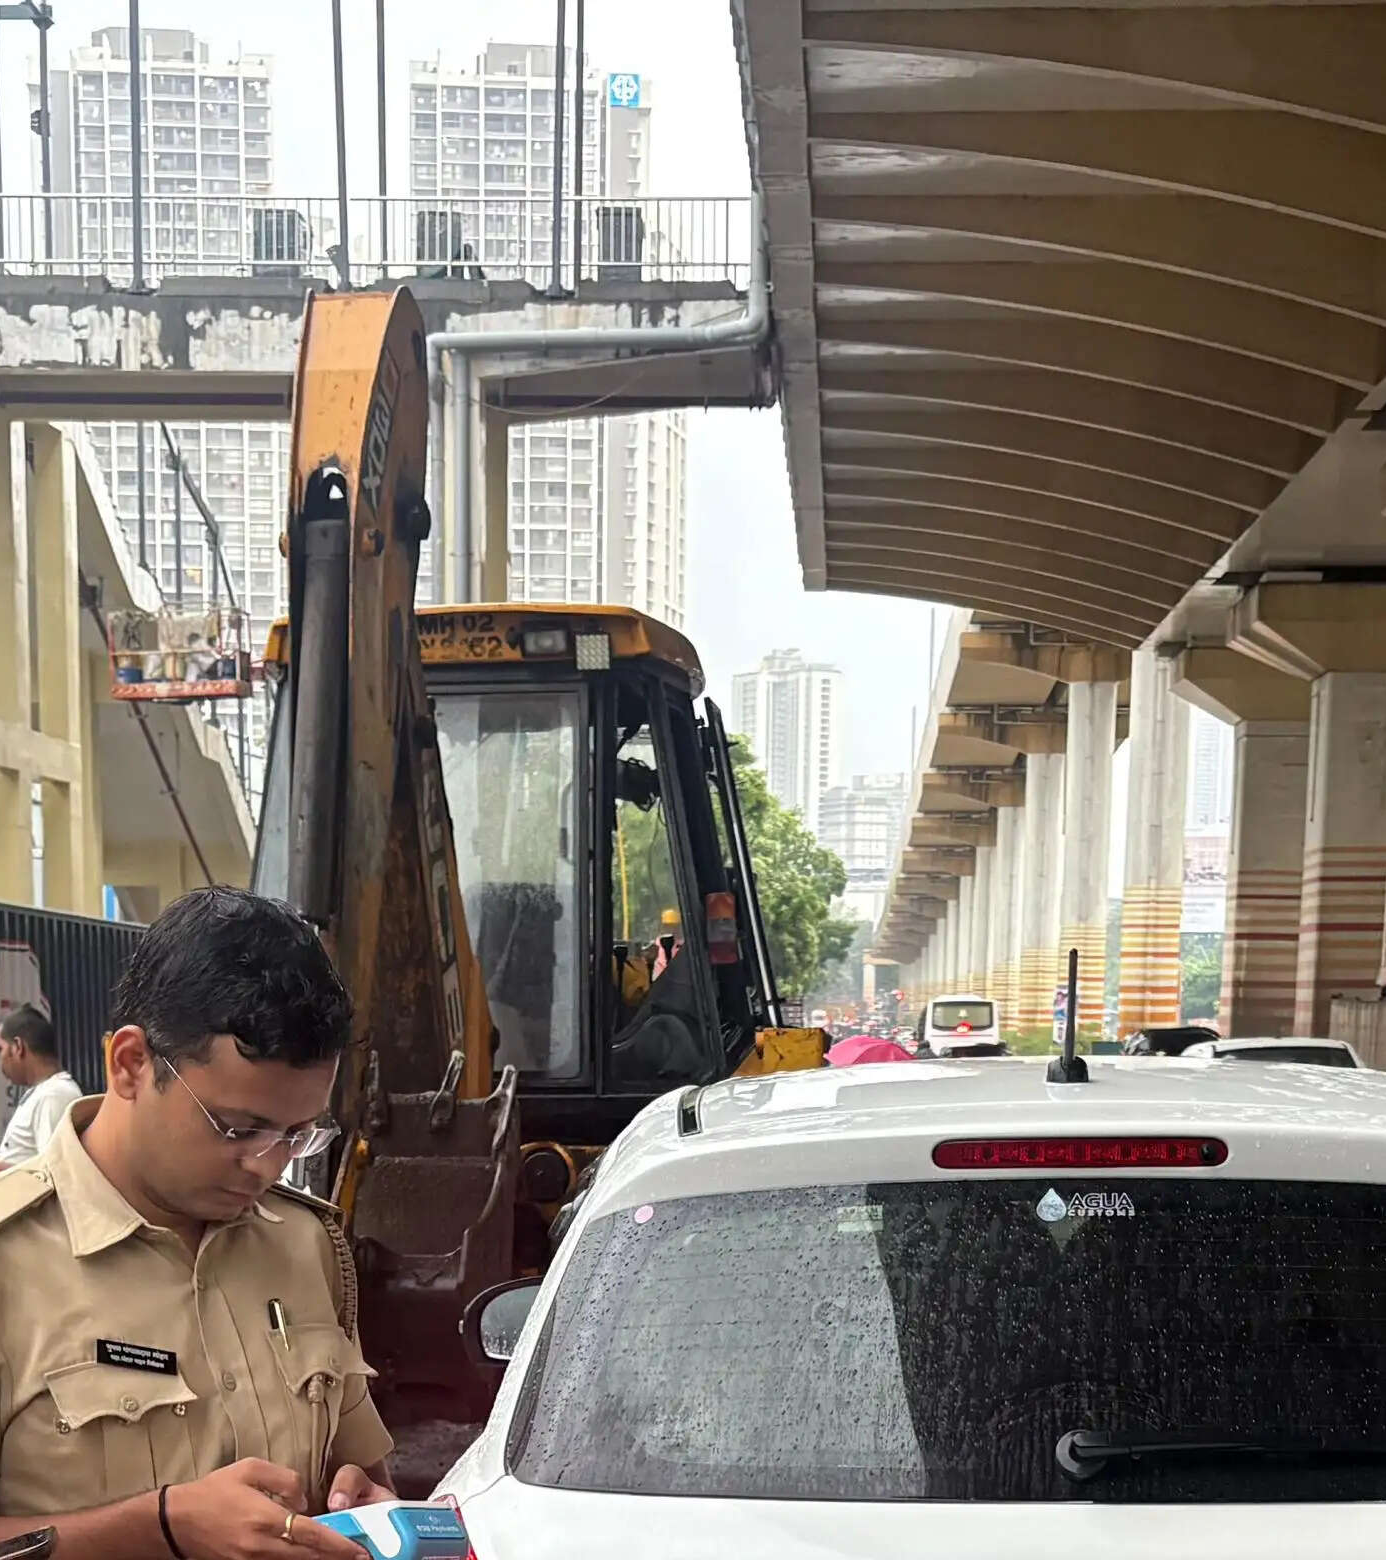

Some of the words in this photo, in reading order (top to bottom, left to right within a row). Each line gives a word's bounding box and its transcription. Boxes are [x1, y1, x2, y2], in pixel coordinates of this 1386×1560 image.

[463, 613, 494, 632] 02
[1068, 1193, 1134, 1209] AGUA
[1068, 1209, 1135, 1217] CUSTOMS
